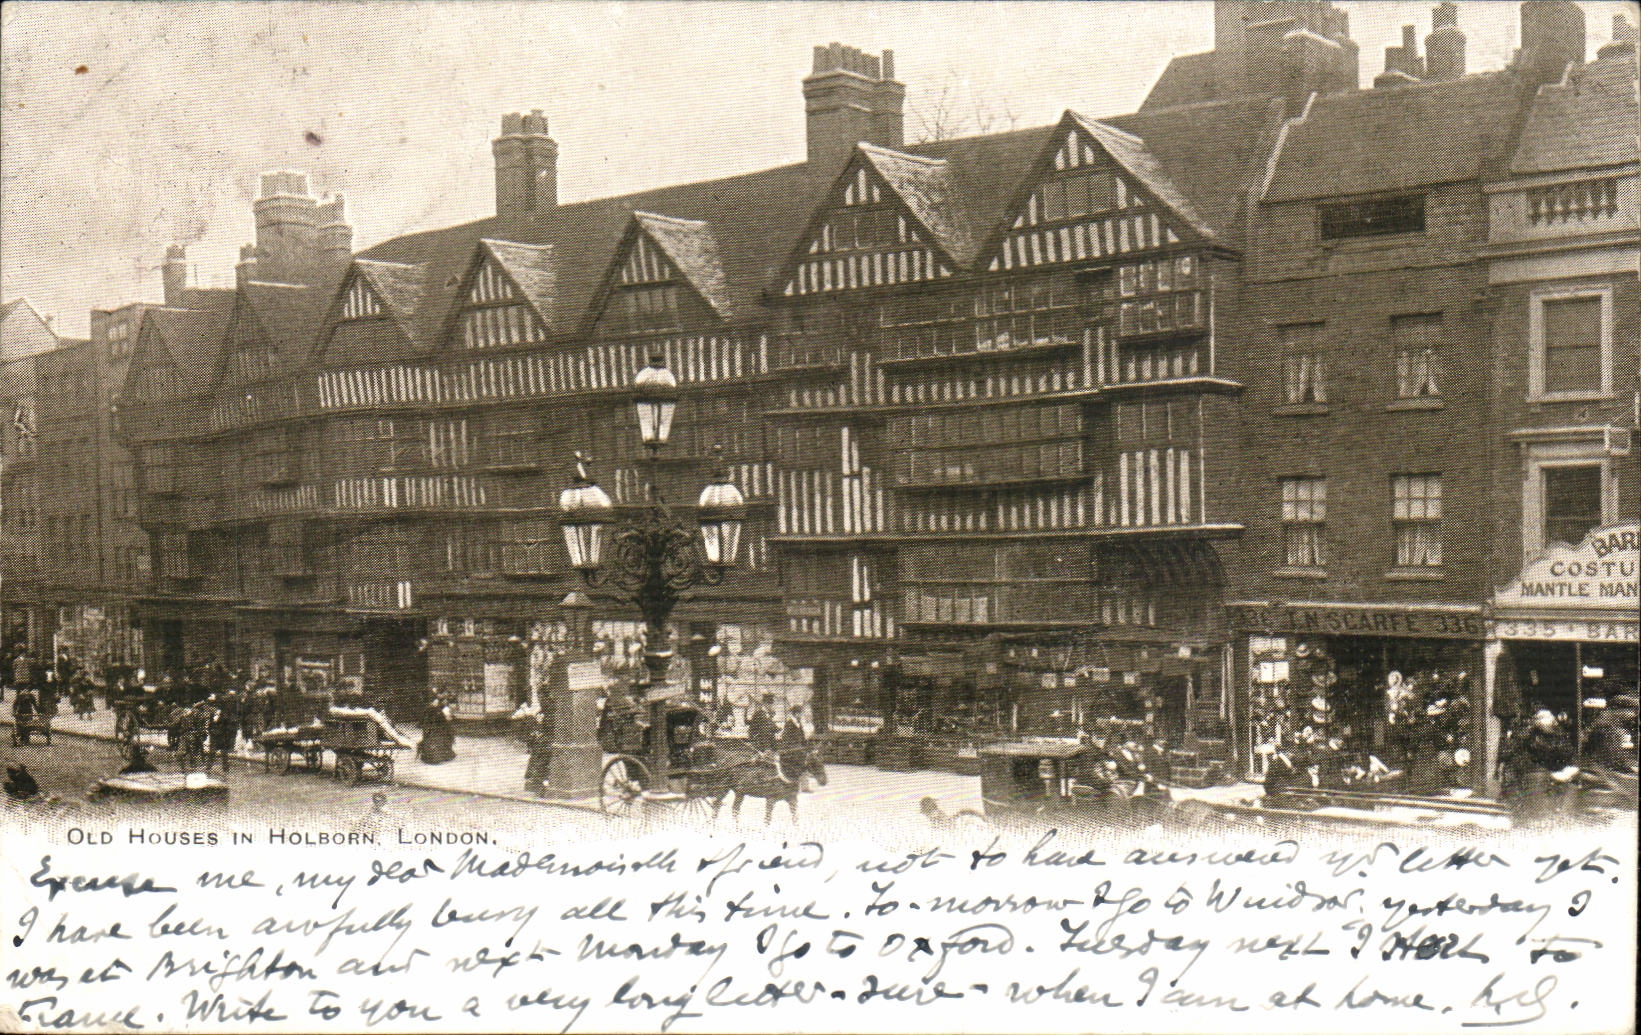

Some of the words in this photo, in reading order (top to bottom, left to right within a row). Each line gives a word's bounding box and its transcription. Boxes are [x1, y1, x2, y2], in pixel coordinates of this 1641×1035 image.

[1592, 531, 1640, 558] BAR
[1521, 582, 1590, 597] MANTLE
[1599, 582, 1638, 598] MAN
[1550, 560, 1635, 577] COSTU
[1433, 614, 1479, 635] 336
[293, 872, 356, 910] my
[367, 858, 446, 886] dear
[856, 847, 956, 874] not
[970, 836, 1007, 870] to
[1023, 828, 1106, 868] have
[1124, 840, 1300, 866] answered
[1399, 847, 1511, 874] letter
[13, 906, 39, 947] I
[47, 913, 133, 943] have
[149, 903, 229, 939] been
[252, 902, 413, 957] awfully
[431, 898, 539, 948] busy
[561, 897, 628, 921] all
[648, 891, 706, 923] this
[1164, 882, 1194, 915] to
[1567, 889, 1592, 917] I
[6, 966, 69, 991] was
[79, 957, 133, 983] at
[146, 946, 318, 994] Brighton
[336, 948, 431, 977] and
[577, 933, 728, 992] Monday
[767, 929, 811, 979] go
[826, 930, 865, 958] to
[1059, 918, 1210, 988] Tuesday
[1226, 931, 1330, 961] next
[1530, 933, 1603, 964] to
[181, 989, 288, 1024] Write
[308, 990, 341, 1020] to
[360, 998, 442, 1027] you
[462, 996, 481, 1017] a
[506, 987, 592, 1034] very
[605, 975, 703, 1033] long
[705, 976, 826, 1008] letter
[1004, 967, 1124, 1008] when
[1138, 967, 1158, 1007] I
[1160, 989, 1249, 1012] am
[1266, 982, 1321, 1010] at
